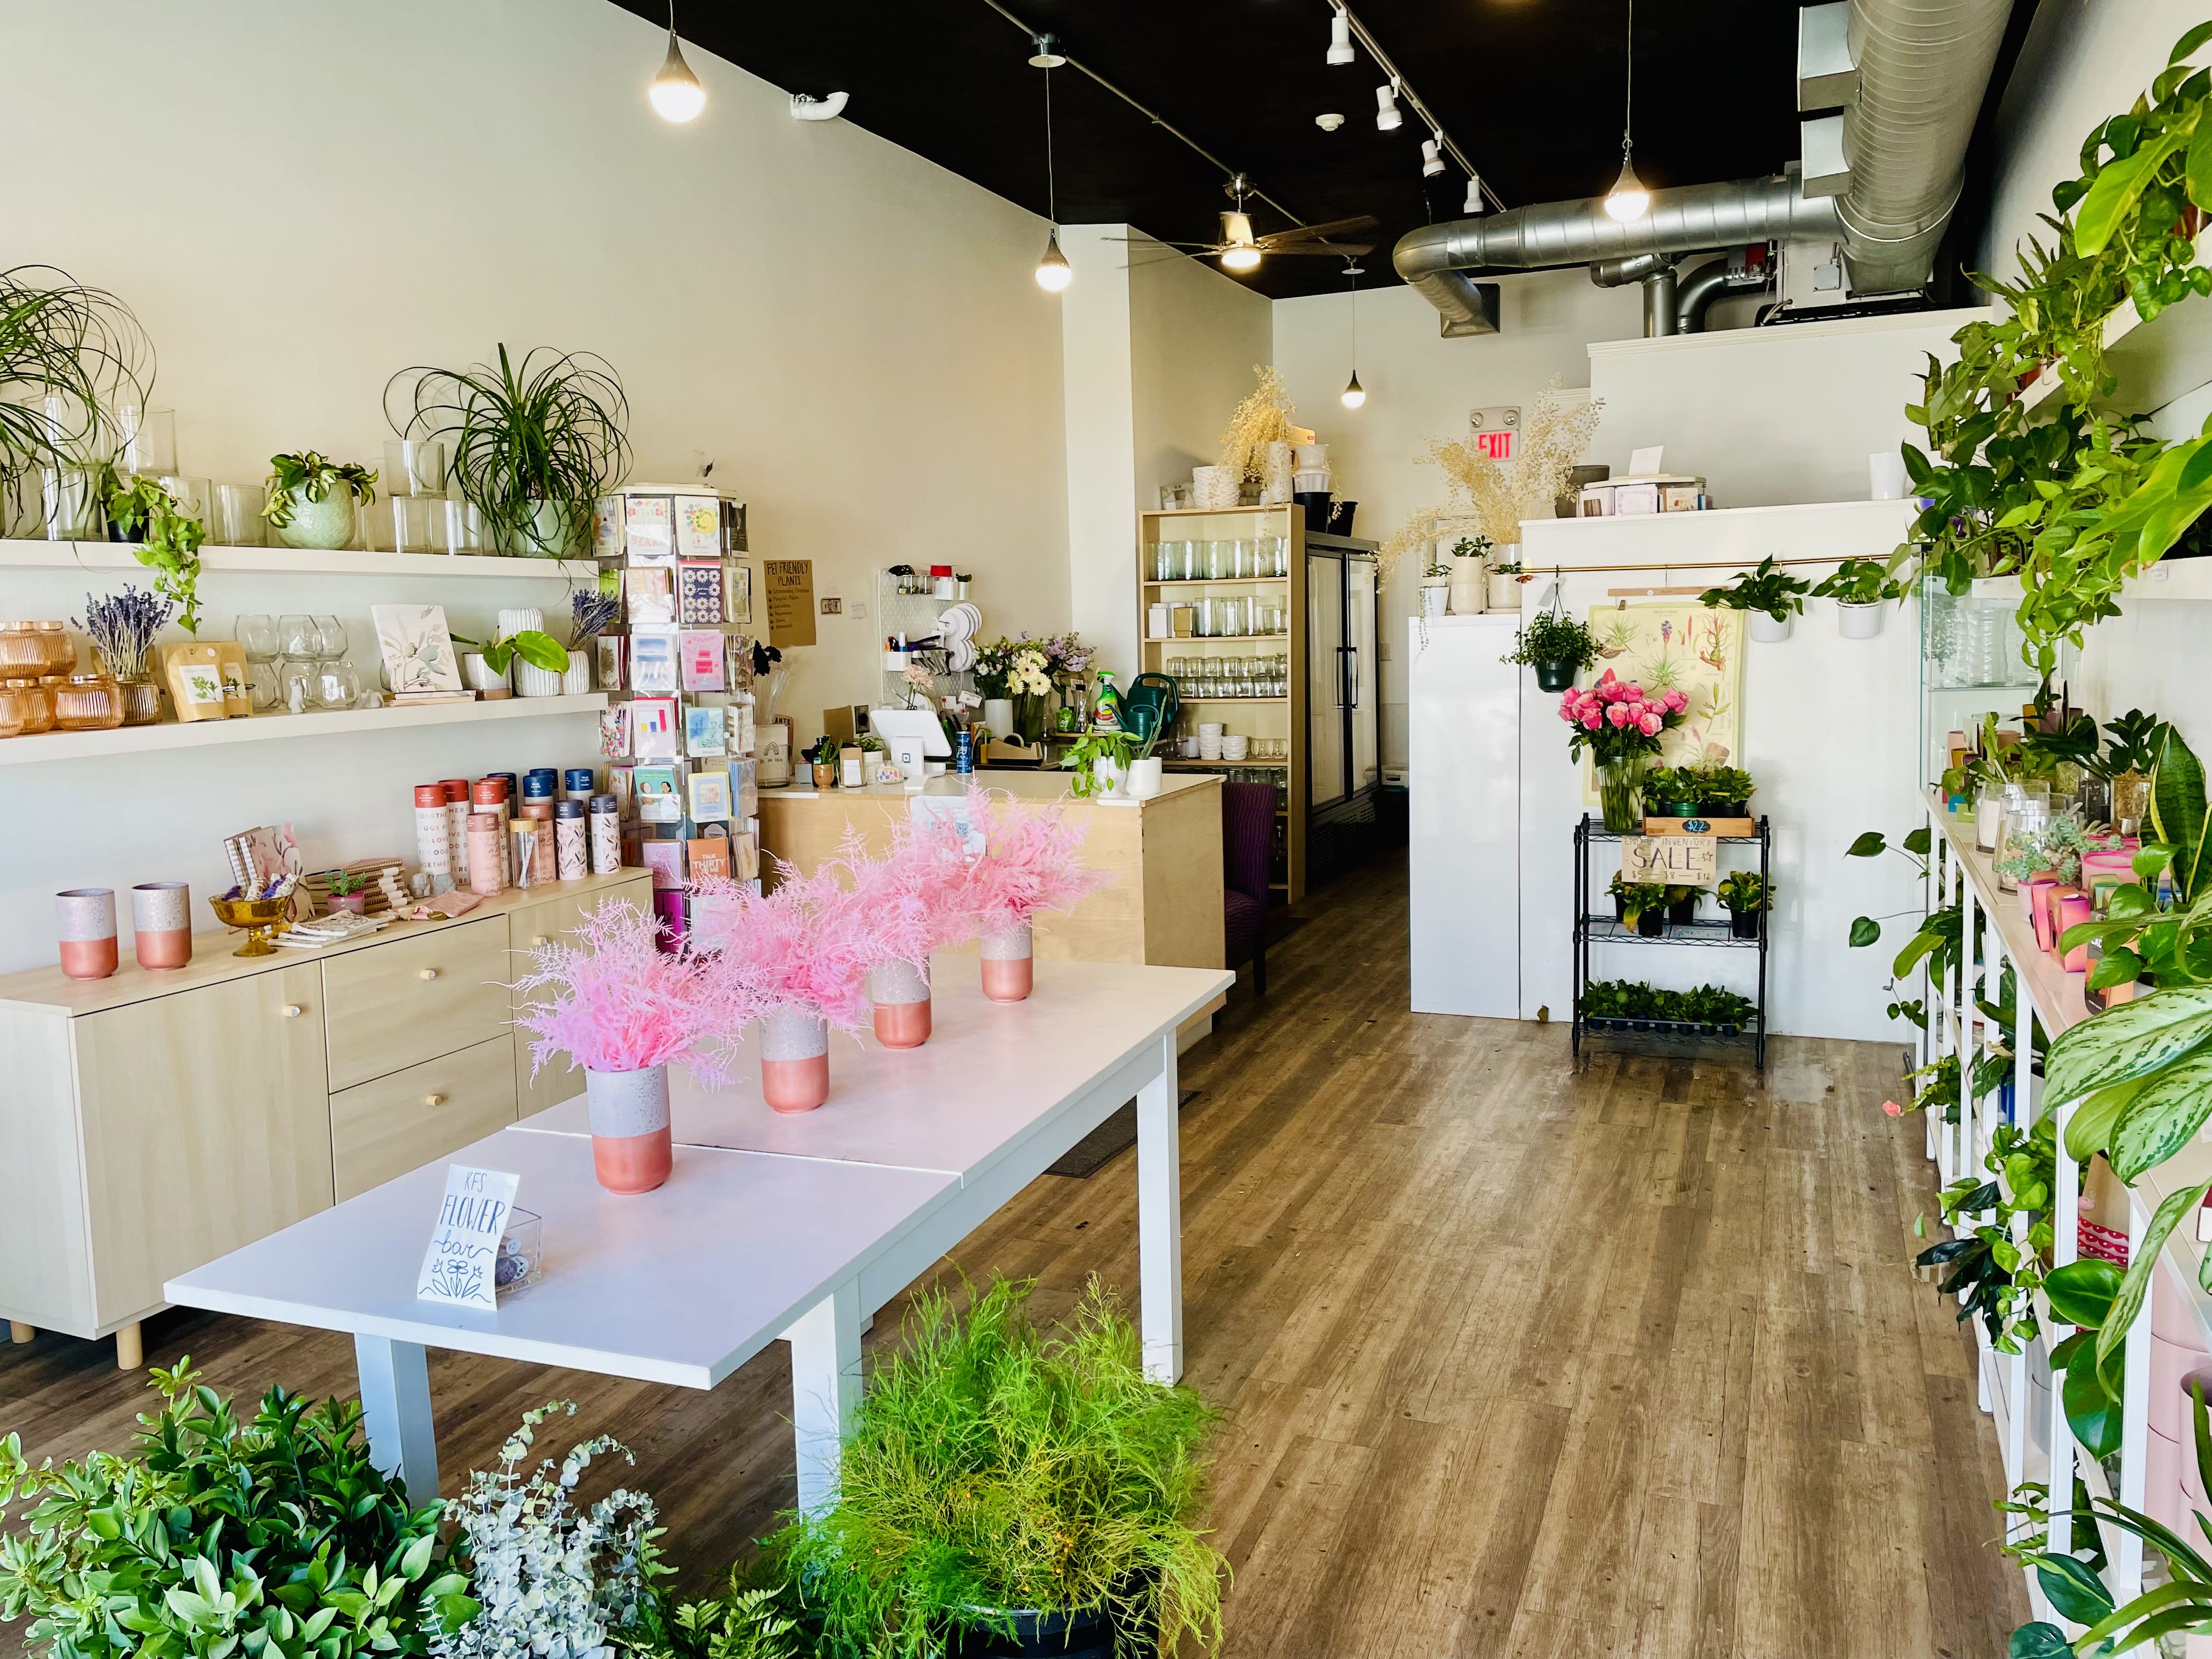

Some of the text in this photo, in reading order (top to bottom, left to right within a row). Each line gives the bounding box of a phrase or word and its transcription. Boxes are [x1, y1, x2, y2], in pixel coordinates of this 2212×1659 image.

[1479, 432, 1512, 459] EXIT
[767, 561, 808, 575] PET FRIENDLY
[778, 575, 801, 586] PLANTS
[1688, 820, 1705, 833] $22
[1646, 838, 1657, 846] OF
[1662, 837, 1711, 847] INVENTORY
[693, 858, 725, 870] THIRTY
[1632, 847, 1702, 871] SALE
[1632, 870, 1711, 881] $5 $8 $12
[464, 1172, 487, 1193] KFS
[439, 1194, 505, 1234] FLOWER
[434, 1229, 493, 1259] bar
